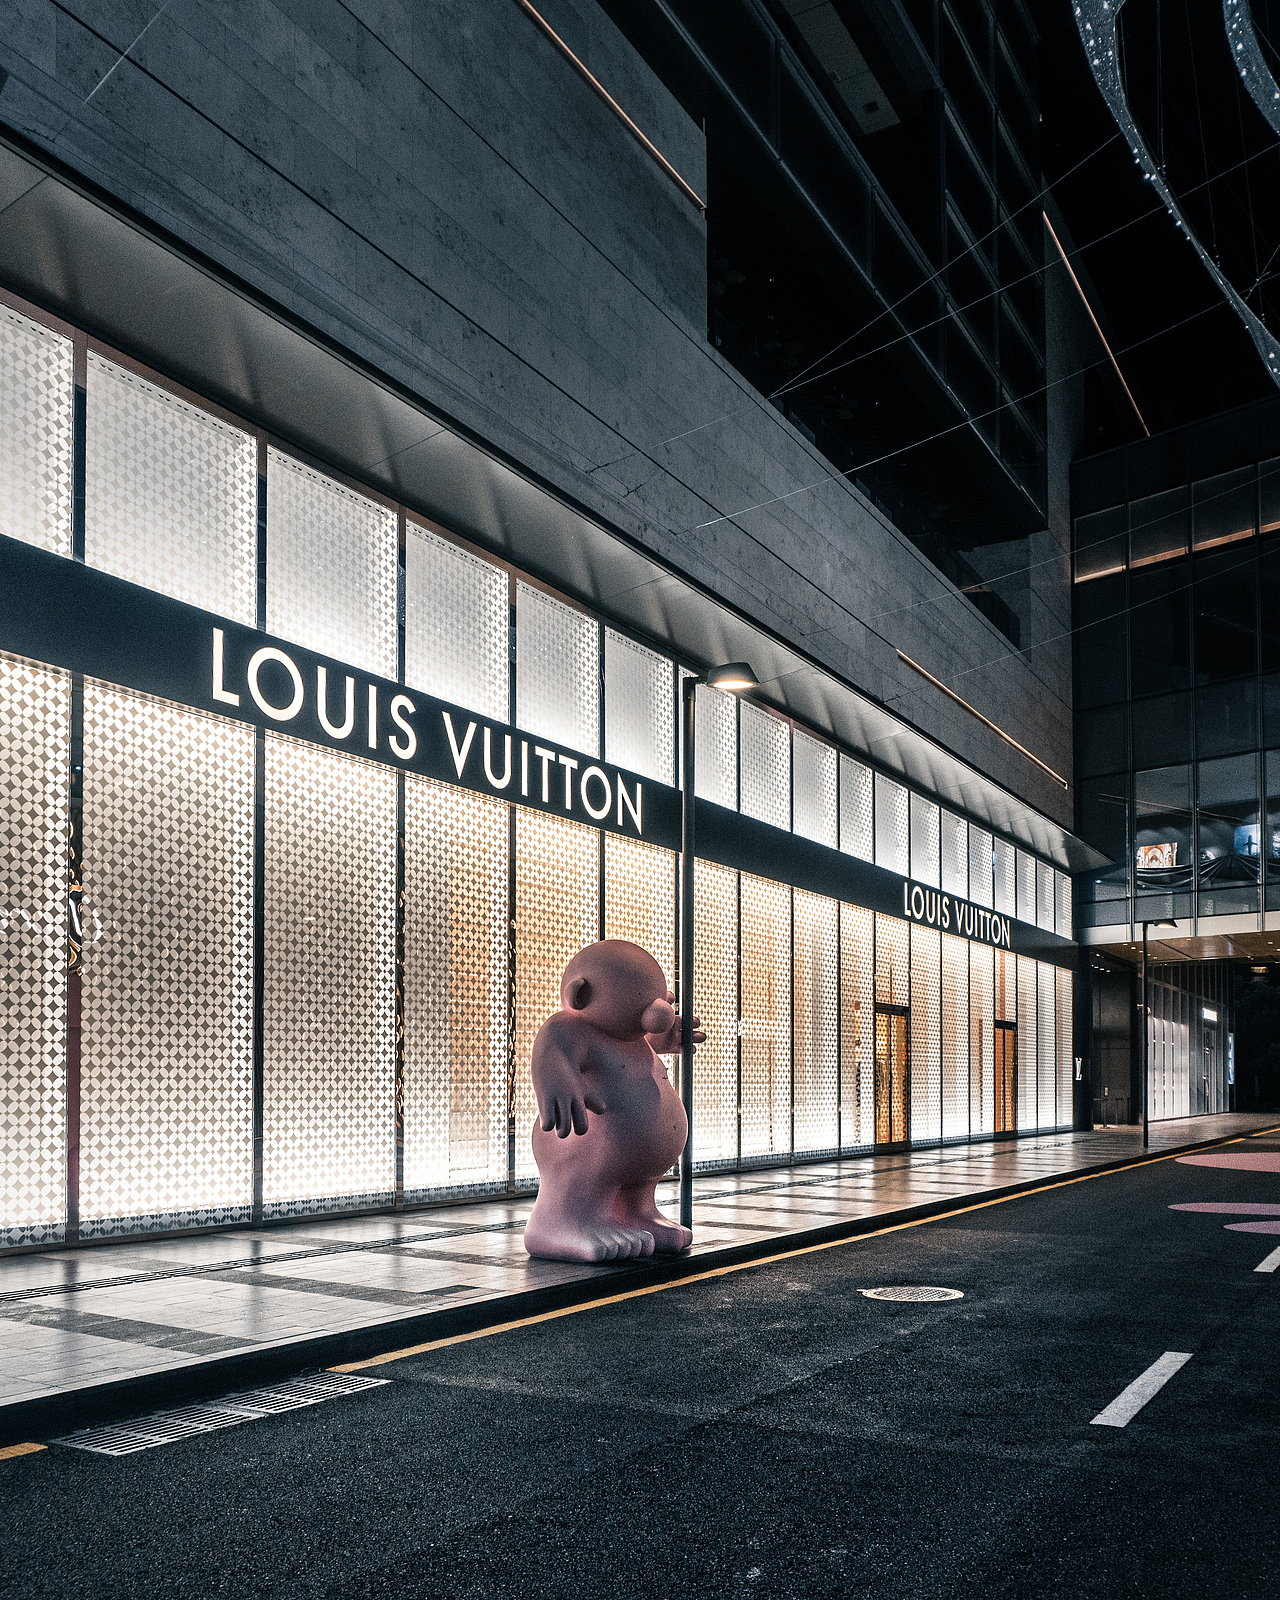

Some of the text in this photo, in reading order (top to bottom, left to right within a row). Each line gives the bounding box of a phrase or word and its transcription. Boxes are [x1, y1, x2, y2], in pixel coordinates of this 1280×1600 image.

[212, 627, 643, 836] LOUIS VUITTON
[904, 881, 1011, 949] LOUIS VUITTON
